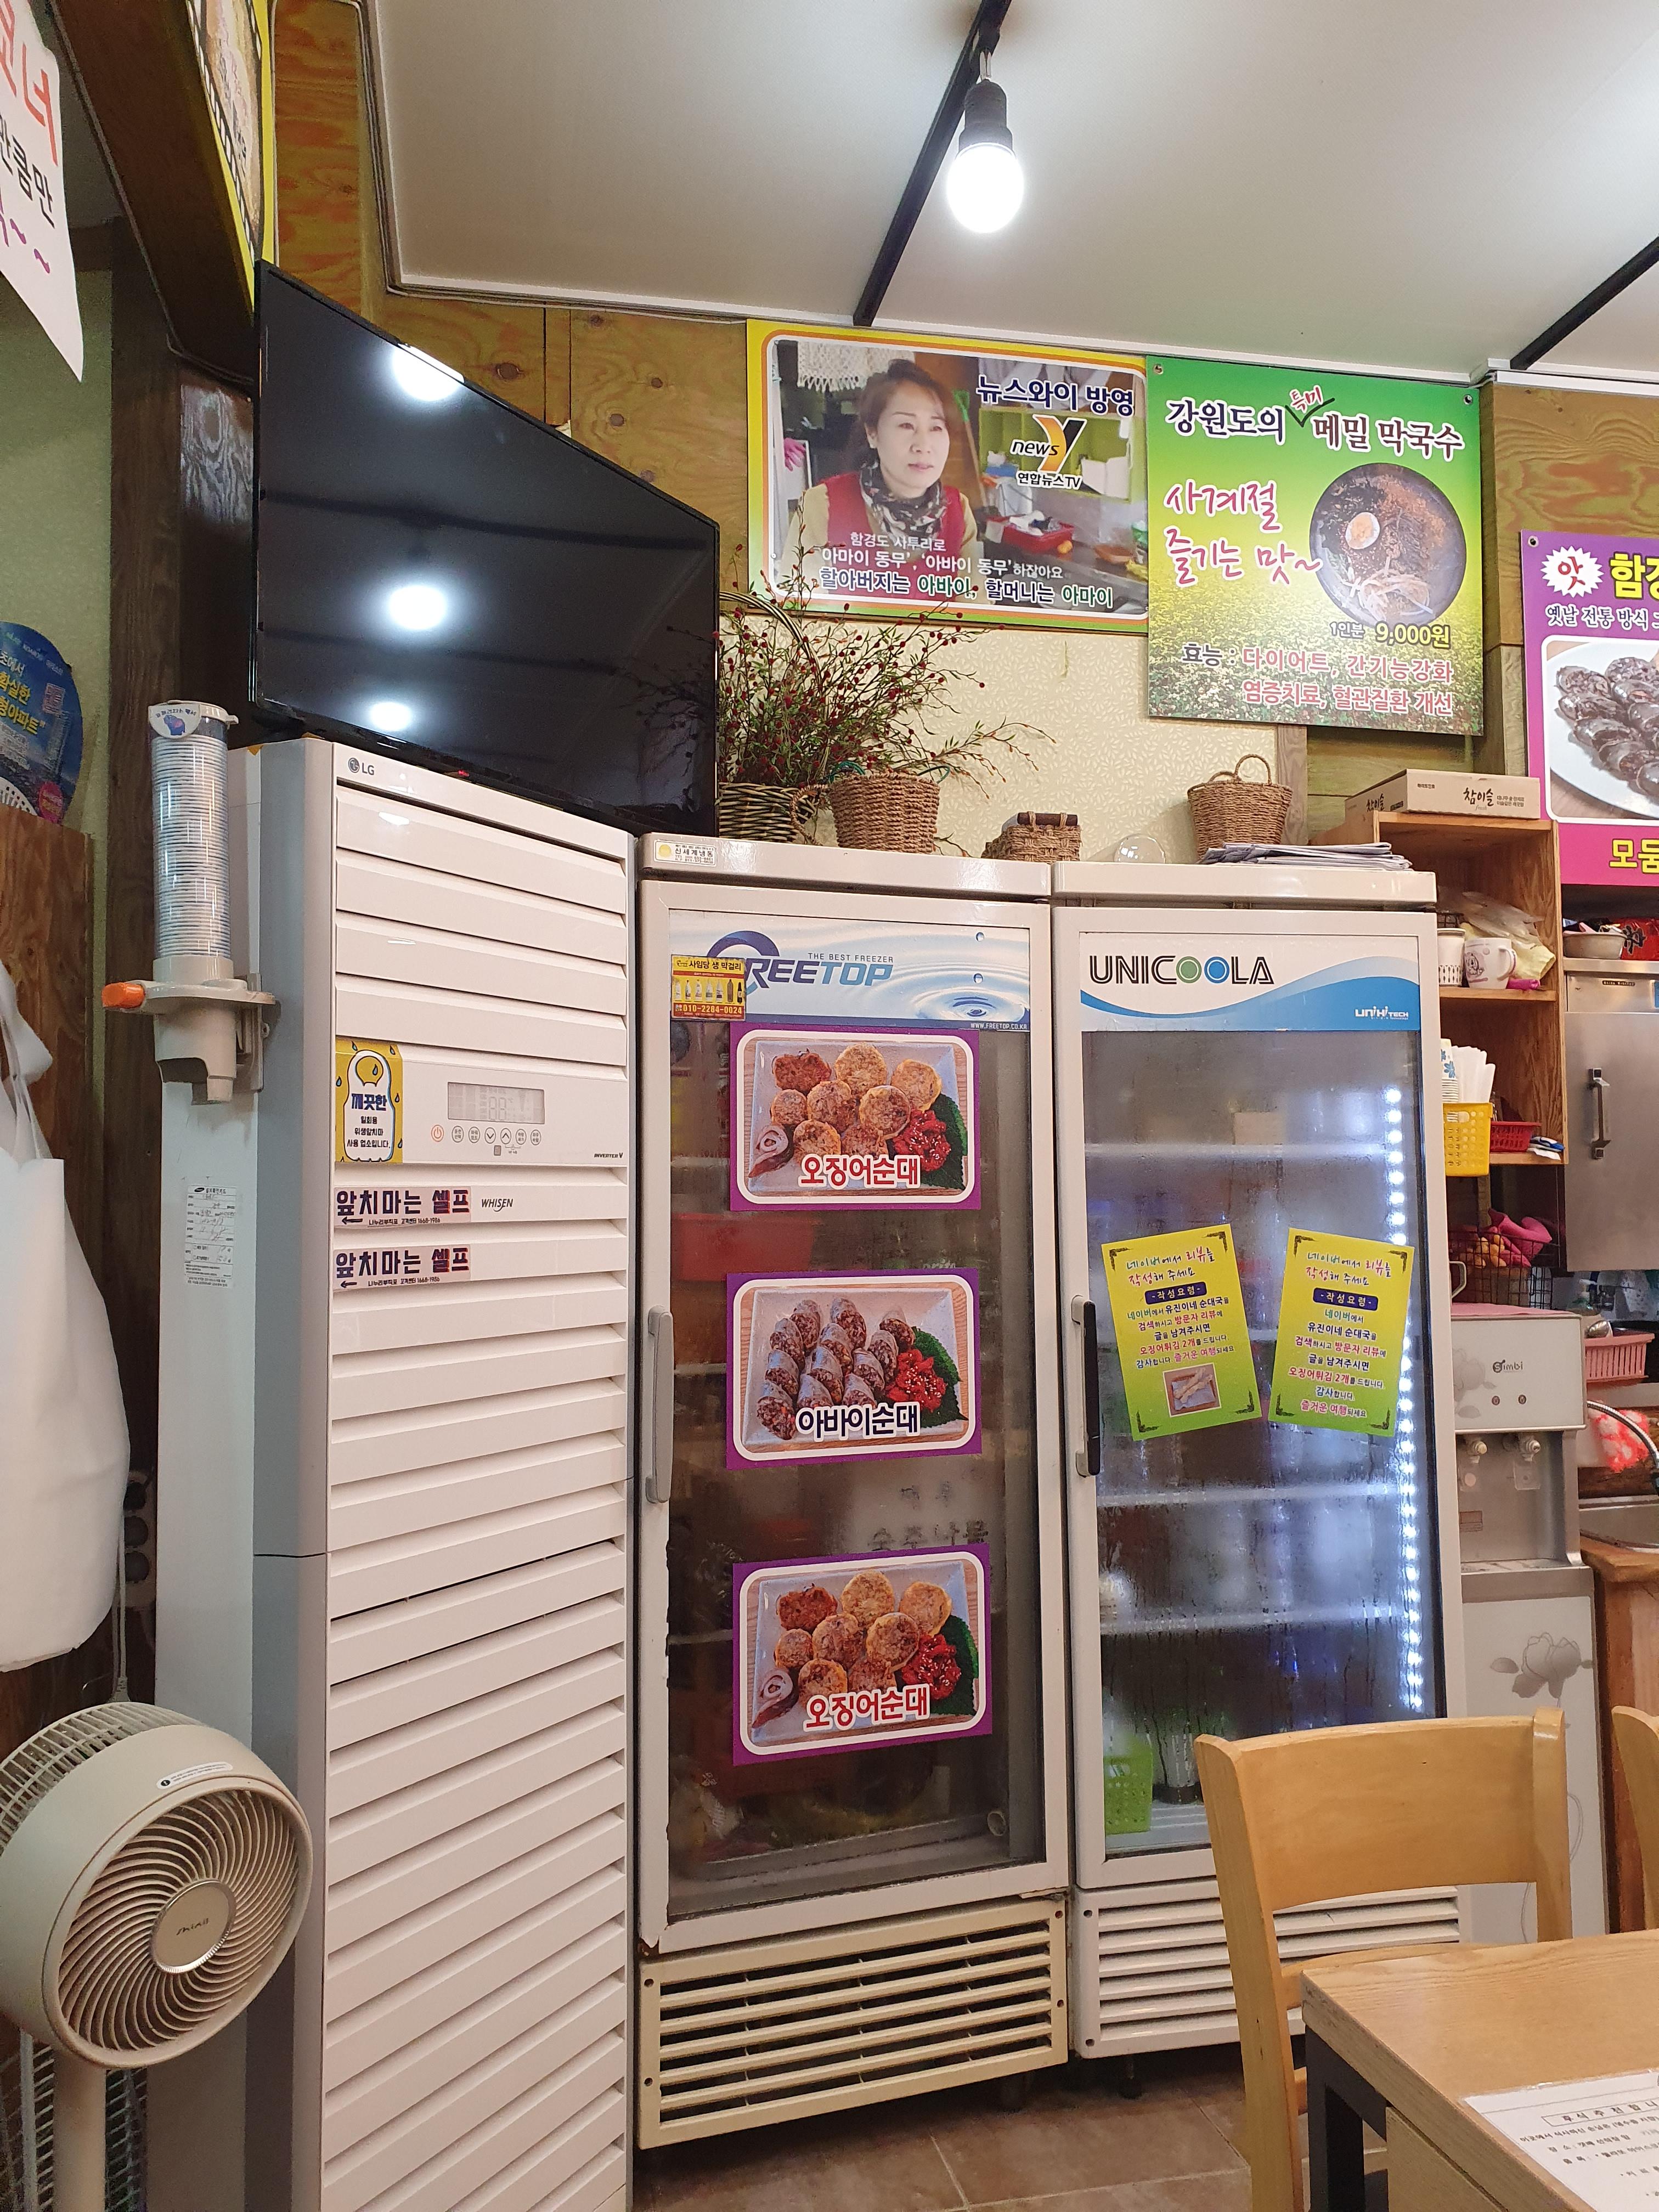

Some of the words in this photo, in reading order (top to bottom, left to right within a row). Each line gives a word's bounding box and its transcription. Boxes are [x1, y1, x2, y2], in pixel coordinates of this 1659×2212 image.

[977, 376, 1077, 409] 뉴스와이
[1086, 387, 1135, 415] 방영
[1290, 386, 1323, 411] 특미
[1167, 400, 1284, 442] 강원도의
[1313, 413, 1370, 451] 메밀
[1375, 421, 1464, 459] 막국수
[1017, 472, 1082, 489] 연합뉴스TV
[1165, 482, 1280, 531] 사계절
[850, 532, 890, 548] 함경도
[894, 536, 946, 551] 사투리로
[822, 548, 870, 566] 아마이
[1166, 529, 1242, 585] 즐기는
[820, 567, 911, 593] 할아버지는
[986, 579, 1054, 603] 할머니는
[1063, 586, 1114, 607] 아마이
[1547, 606, 1578, 627] 옛날
[1582, 608, 1613, 628] 전통
[1618, 610, 1647, 629] 방식
[1330, 622, 1364, 637] 1인분
[1376, 624, 1451, 647] 9,000원
[1183, 644, 1222, 666] 효능
[1244, 647, 1337, 675] 다이어트,
[1348, 656, 1452, 682] 간기능강화
[1244, 681, 1324, 708] 염증치료,
[1334, 687, 1408, 712] 혈관질환
[1415, 695, 1452, 714] 개선
[361, 764, 374, 775] LG
[1463, 787, 1494, 806] 참이슬
[689, 960, 710, 969] 사임당
[721, 962, 741, 970] 막걸리
[1090, 955, 1274, 985] UNICOOLA
[683, 1005, 742, 1014] 010-2284-0024
[351, 1093, 387, 1111] 깨끗한
[360, 1116, 377, 1124] 일회용
[799, 1155, 919, 1187] 오징어순대
[337, 1190, 421, 1216] 앞치마는
[432, 1189, 470, 1215] 셀프
[481, 1198, 513, 1211] WHISEN
[336, 1250, 421, 1278] 앞치마는
[432, 1248, 470, 1273] 셀프
[1127, 1253, 1182, 1270] 네이버에서
[1186, 1246, 1215, 1263] 리뷰를
[1307, 1252, 1361, 1269] 네이버에서
[1366, 1260, 1391, 1278] 리뷰를
[1128, 1271, 1164, 1286] 작성해
[1167, 1267, 1195, 1281] 주세요
[1306, 1267, 1339, 1282] 작성해
[1344, 1273, 1369, 1286] 주세요
[1127, 1308, 1164, 1319] 네이버에서
[1165, 1300, 1198, 1313] 유진이네
[1199, 1296, 1229, 1308] 순대국을
[1325, 1308, 1363, 1323] 네이버에서
[1138, 1319, 1172, 1331] 검색하시고
[1175, 1314, 1198, 1326] 방문자
[1201, 1310, 1223, 1322] 리뷰에
[1154, 1330, 1169, 1341] 글을
[1170, 1323, 1211, 1338] 남겨주시면
[1307, 1322, 1342, 1336] 유진이네
[1345, 1328, 1377, 1341] 순대국을
[1140, 1341, 1180, 1355] 오징어튀김
[1182, 1338, 1201, 1349] 2개를
[1174, 1350, 1198, 1363] 즐거운
[1295, 1336, 1332, 1350] 검색하시고
[1335, 1342, 1360, 1354] 방문자
[1363, 1346, 1386, 1358] 리뷰에
[1308, 1354, 1323, 1364] 글을
[1327, 1357, 1369, 1370] 남겨주시면
[1289, 1367, 1333, 1381] 오징어튀김
[1335, 1373, 1356, 1385] 2개를
[1301, 1400, 1328, 1413] 즐거운
[799, 1403, 919, 1440] 아바이순대
[806, 1685, 928, 1730] 오징어순대
